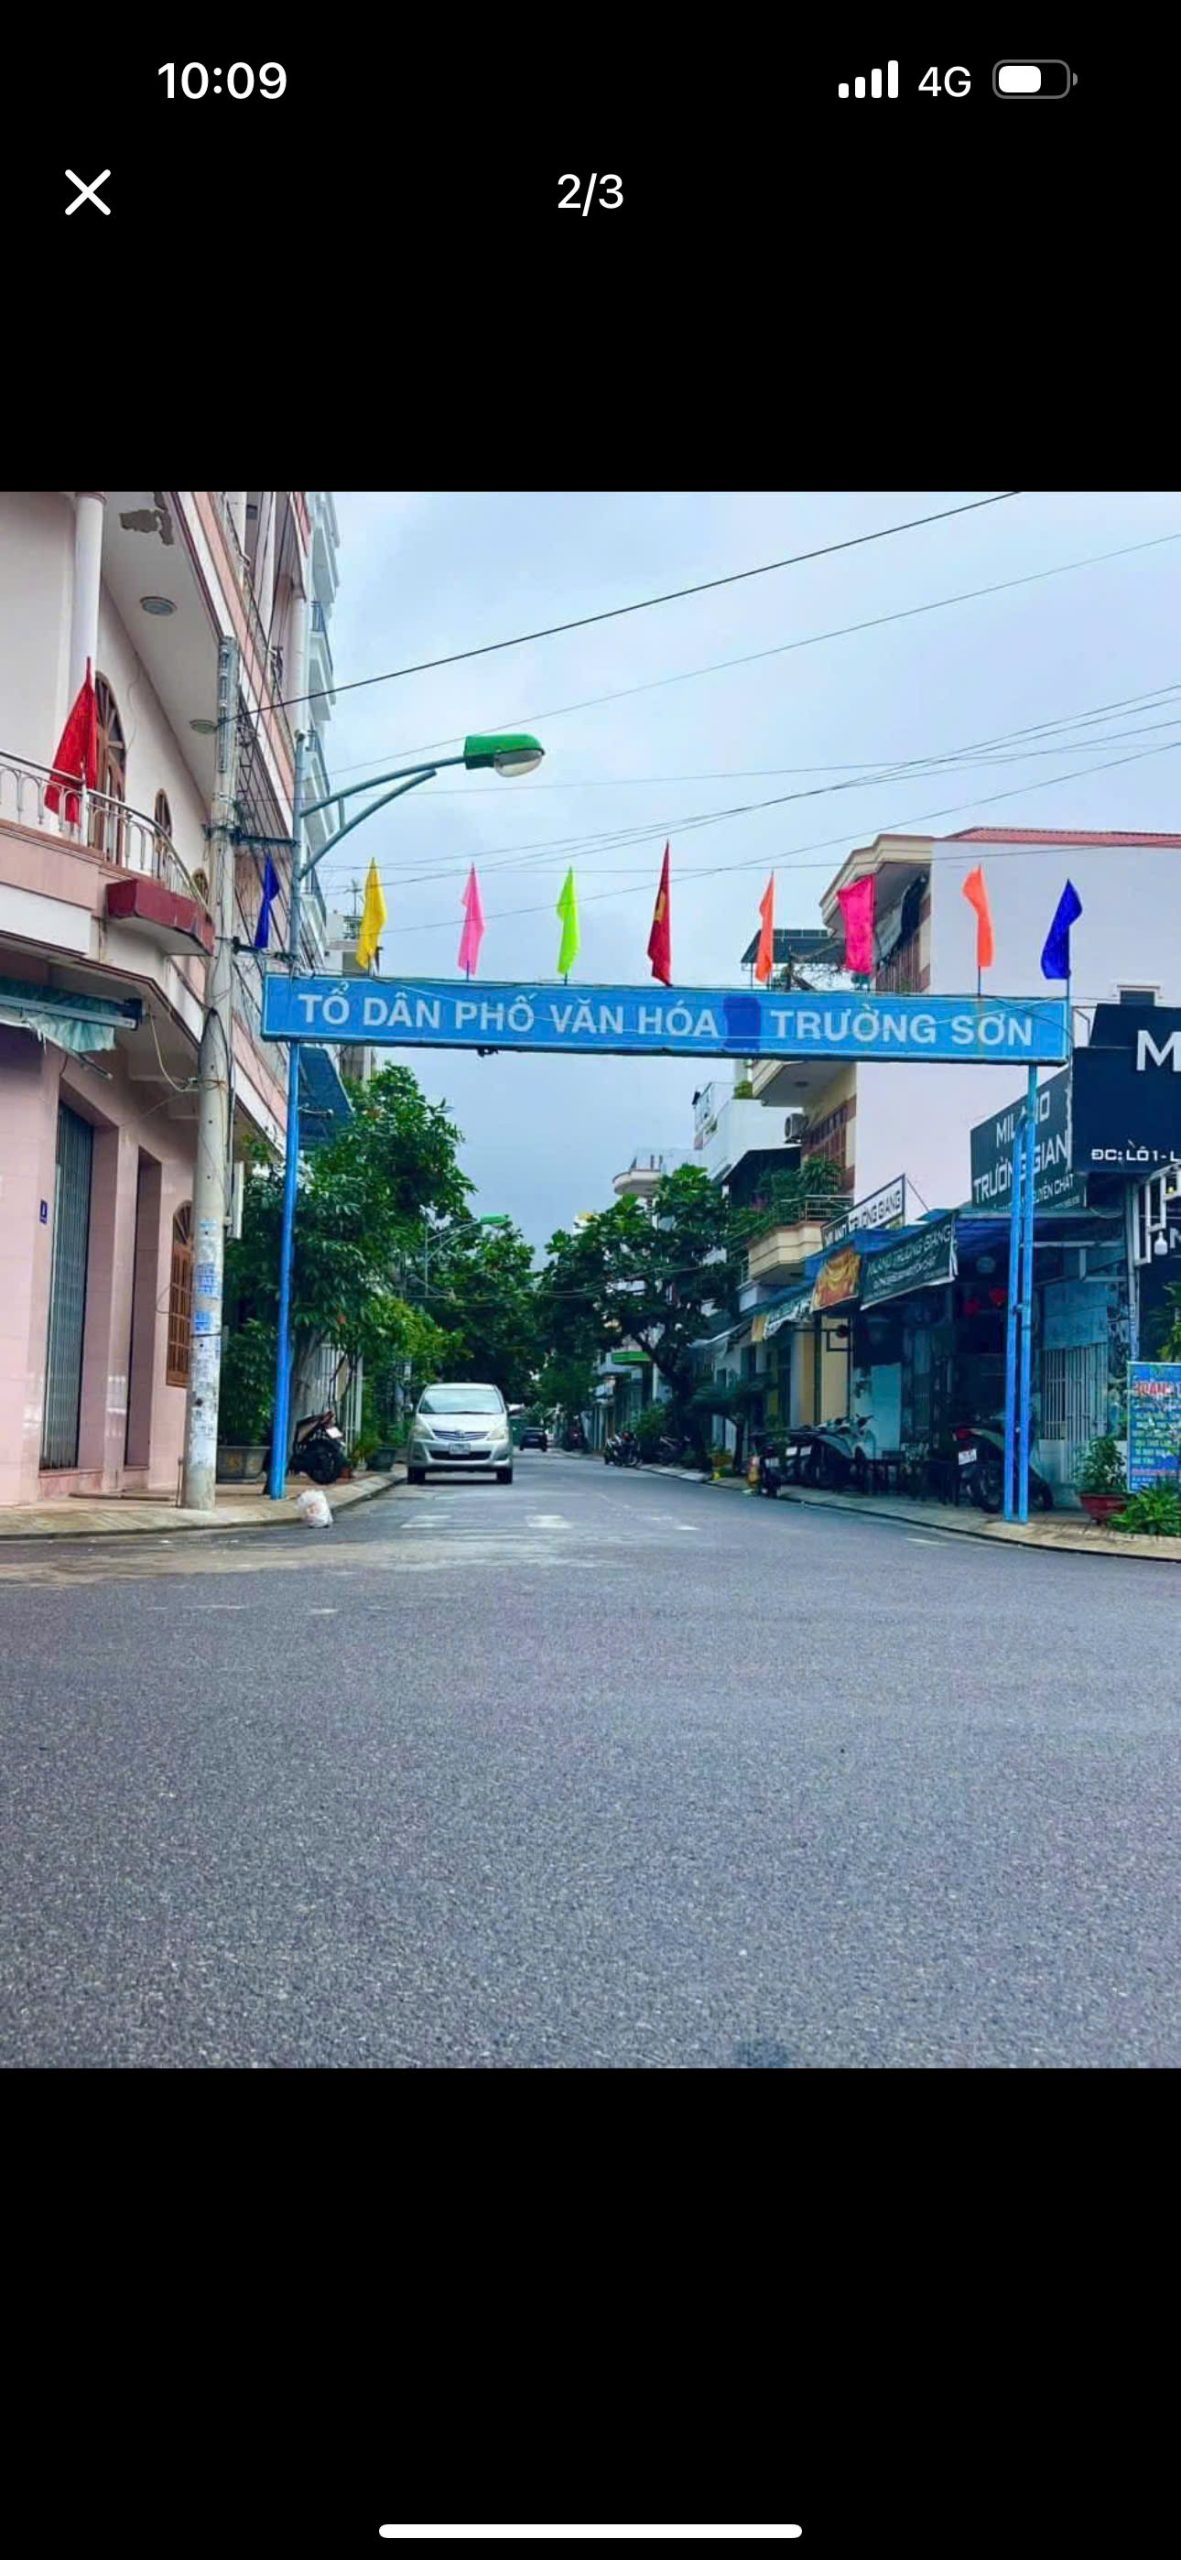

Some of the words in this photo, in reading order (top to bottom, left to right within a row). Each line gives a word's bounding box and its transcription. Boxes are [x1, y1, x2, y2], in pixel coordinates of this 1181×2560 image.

[298, 982, 351, 1025] TỔ
[363, 995, 441, 1030] DÂN
[455, 991, 537, 1032] PHỐ
[549, 999, 625, 1034] VĂN
[638, 999, 720, 1037] HÓA
[770, 1003, 937, 1044] TRƯỜNG
[951, 1013, 1033, 1047] SƠN
